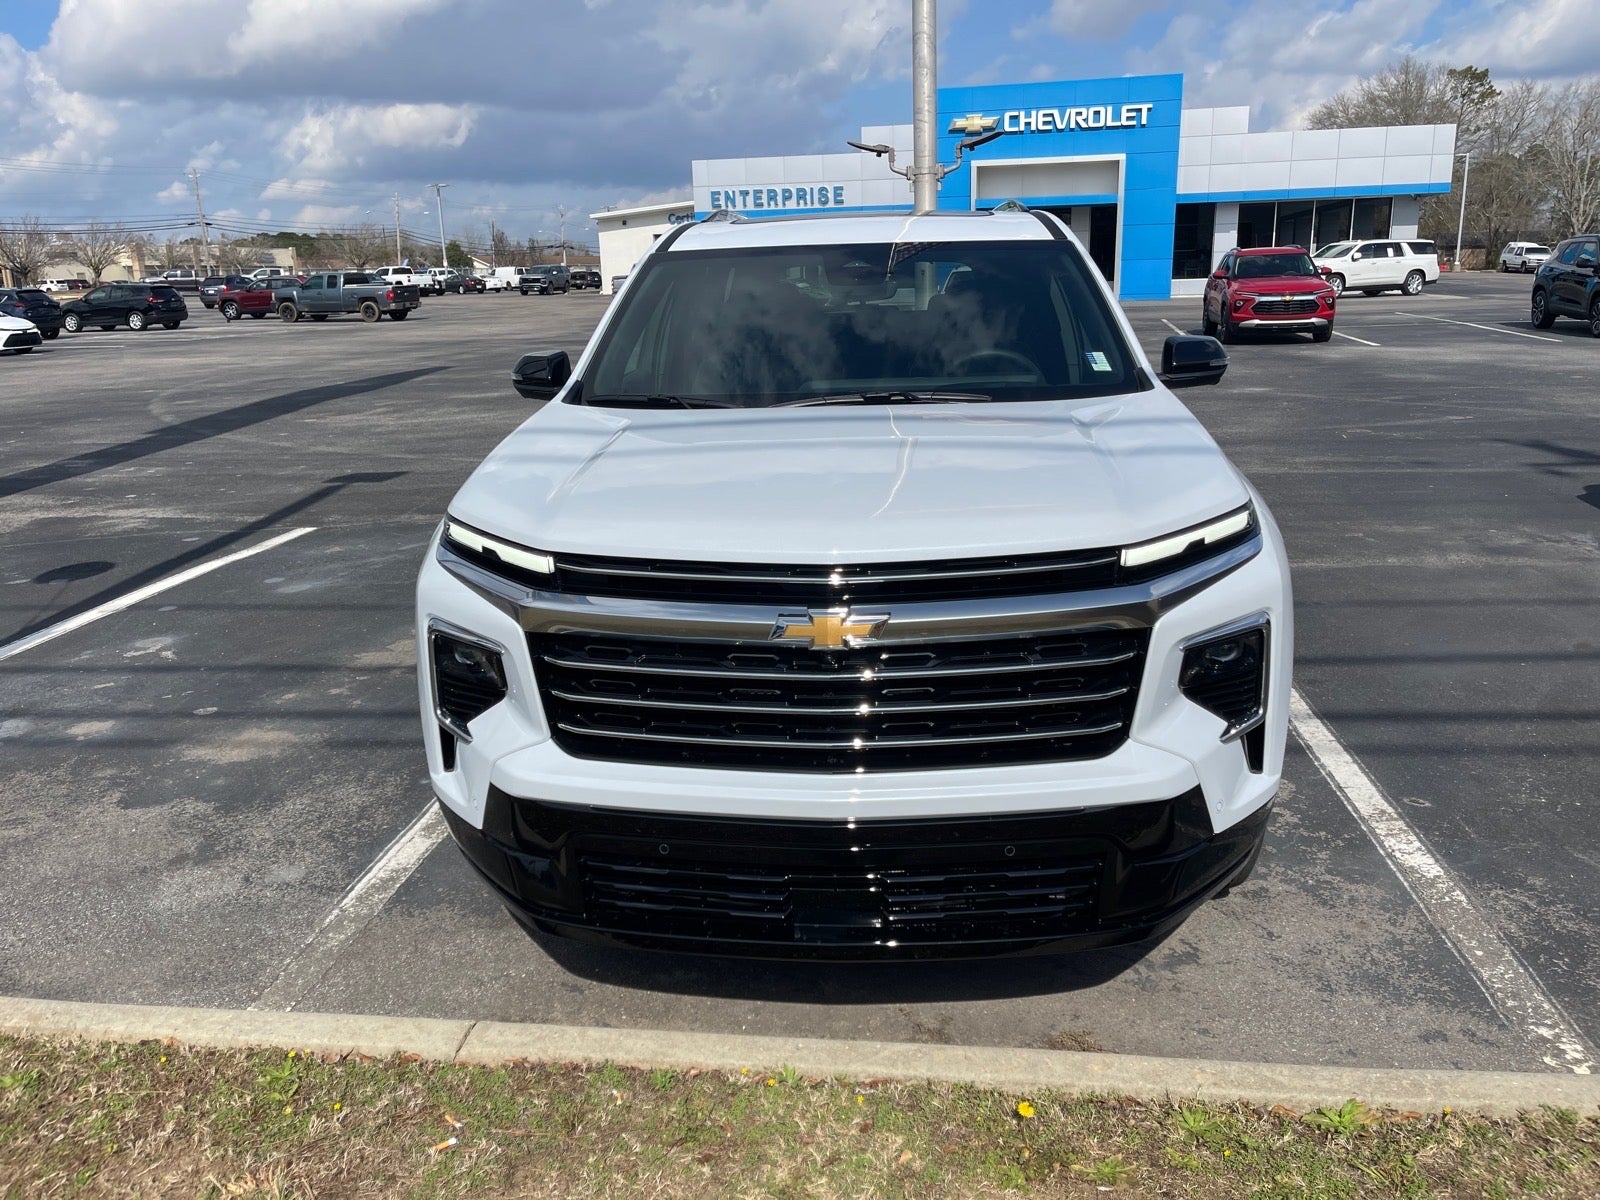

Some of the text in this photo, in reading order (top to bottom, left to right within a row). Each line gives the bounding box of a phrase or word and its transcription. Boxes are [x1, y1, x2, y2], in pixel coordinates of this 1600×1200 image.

[1004, 104, 1153, 133] CHEVROLET
[711, 186, 845, 209] ENTERPRISE
[668, 212, 695, 225] Certi
